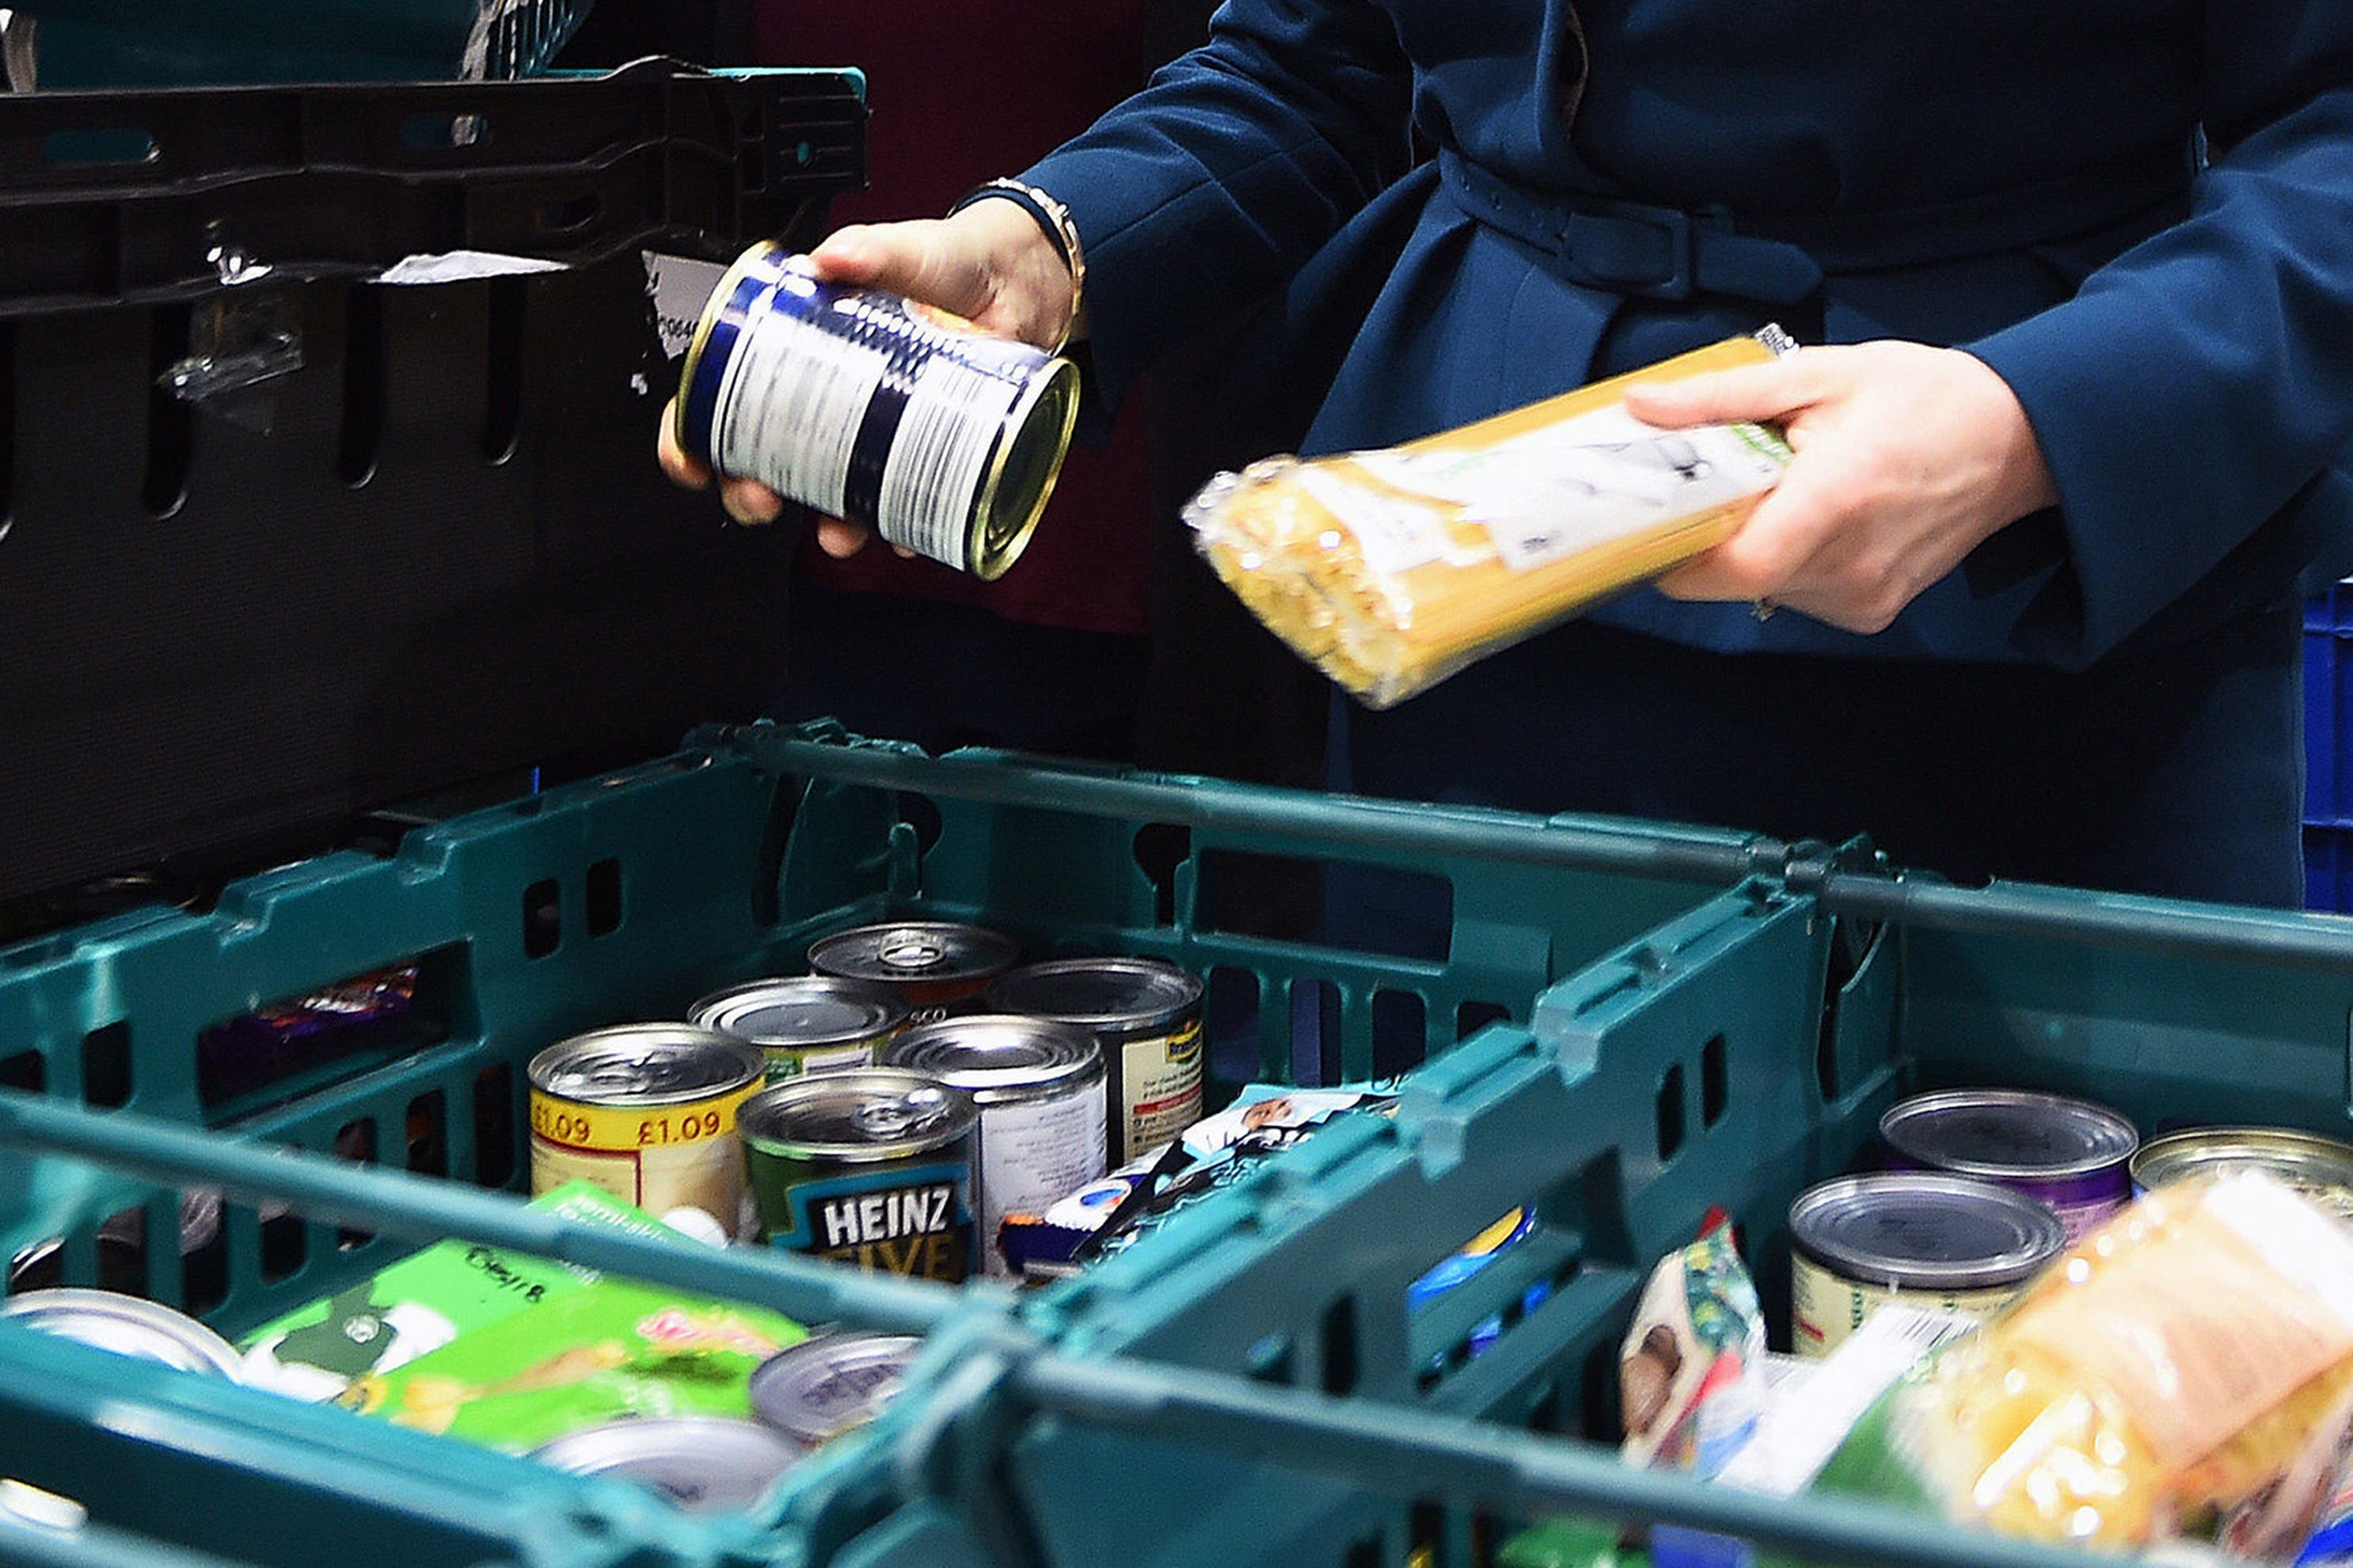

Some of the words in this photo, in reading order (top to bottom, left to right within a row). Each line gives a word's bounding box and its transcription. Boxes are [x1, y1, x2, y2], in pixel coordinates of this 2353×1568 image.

[637, 1111, 720, 1145] £1.09
[824, 1189, 950, 1247] HEINZ
[820, 1232, 953, 1283] IVE
